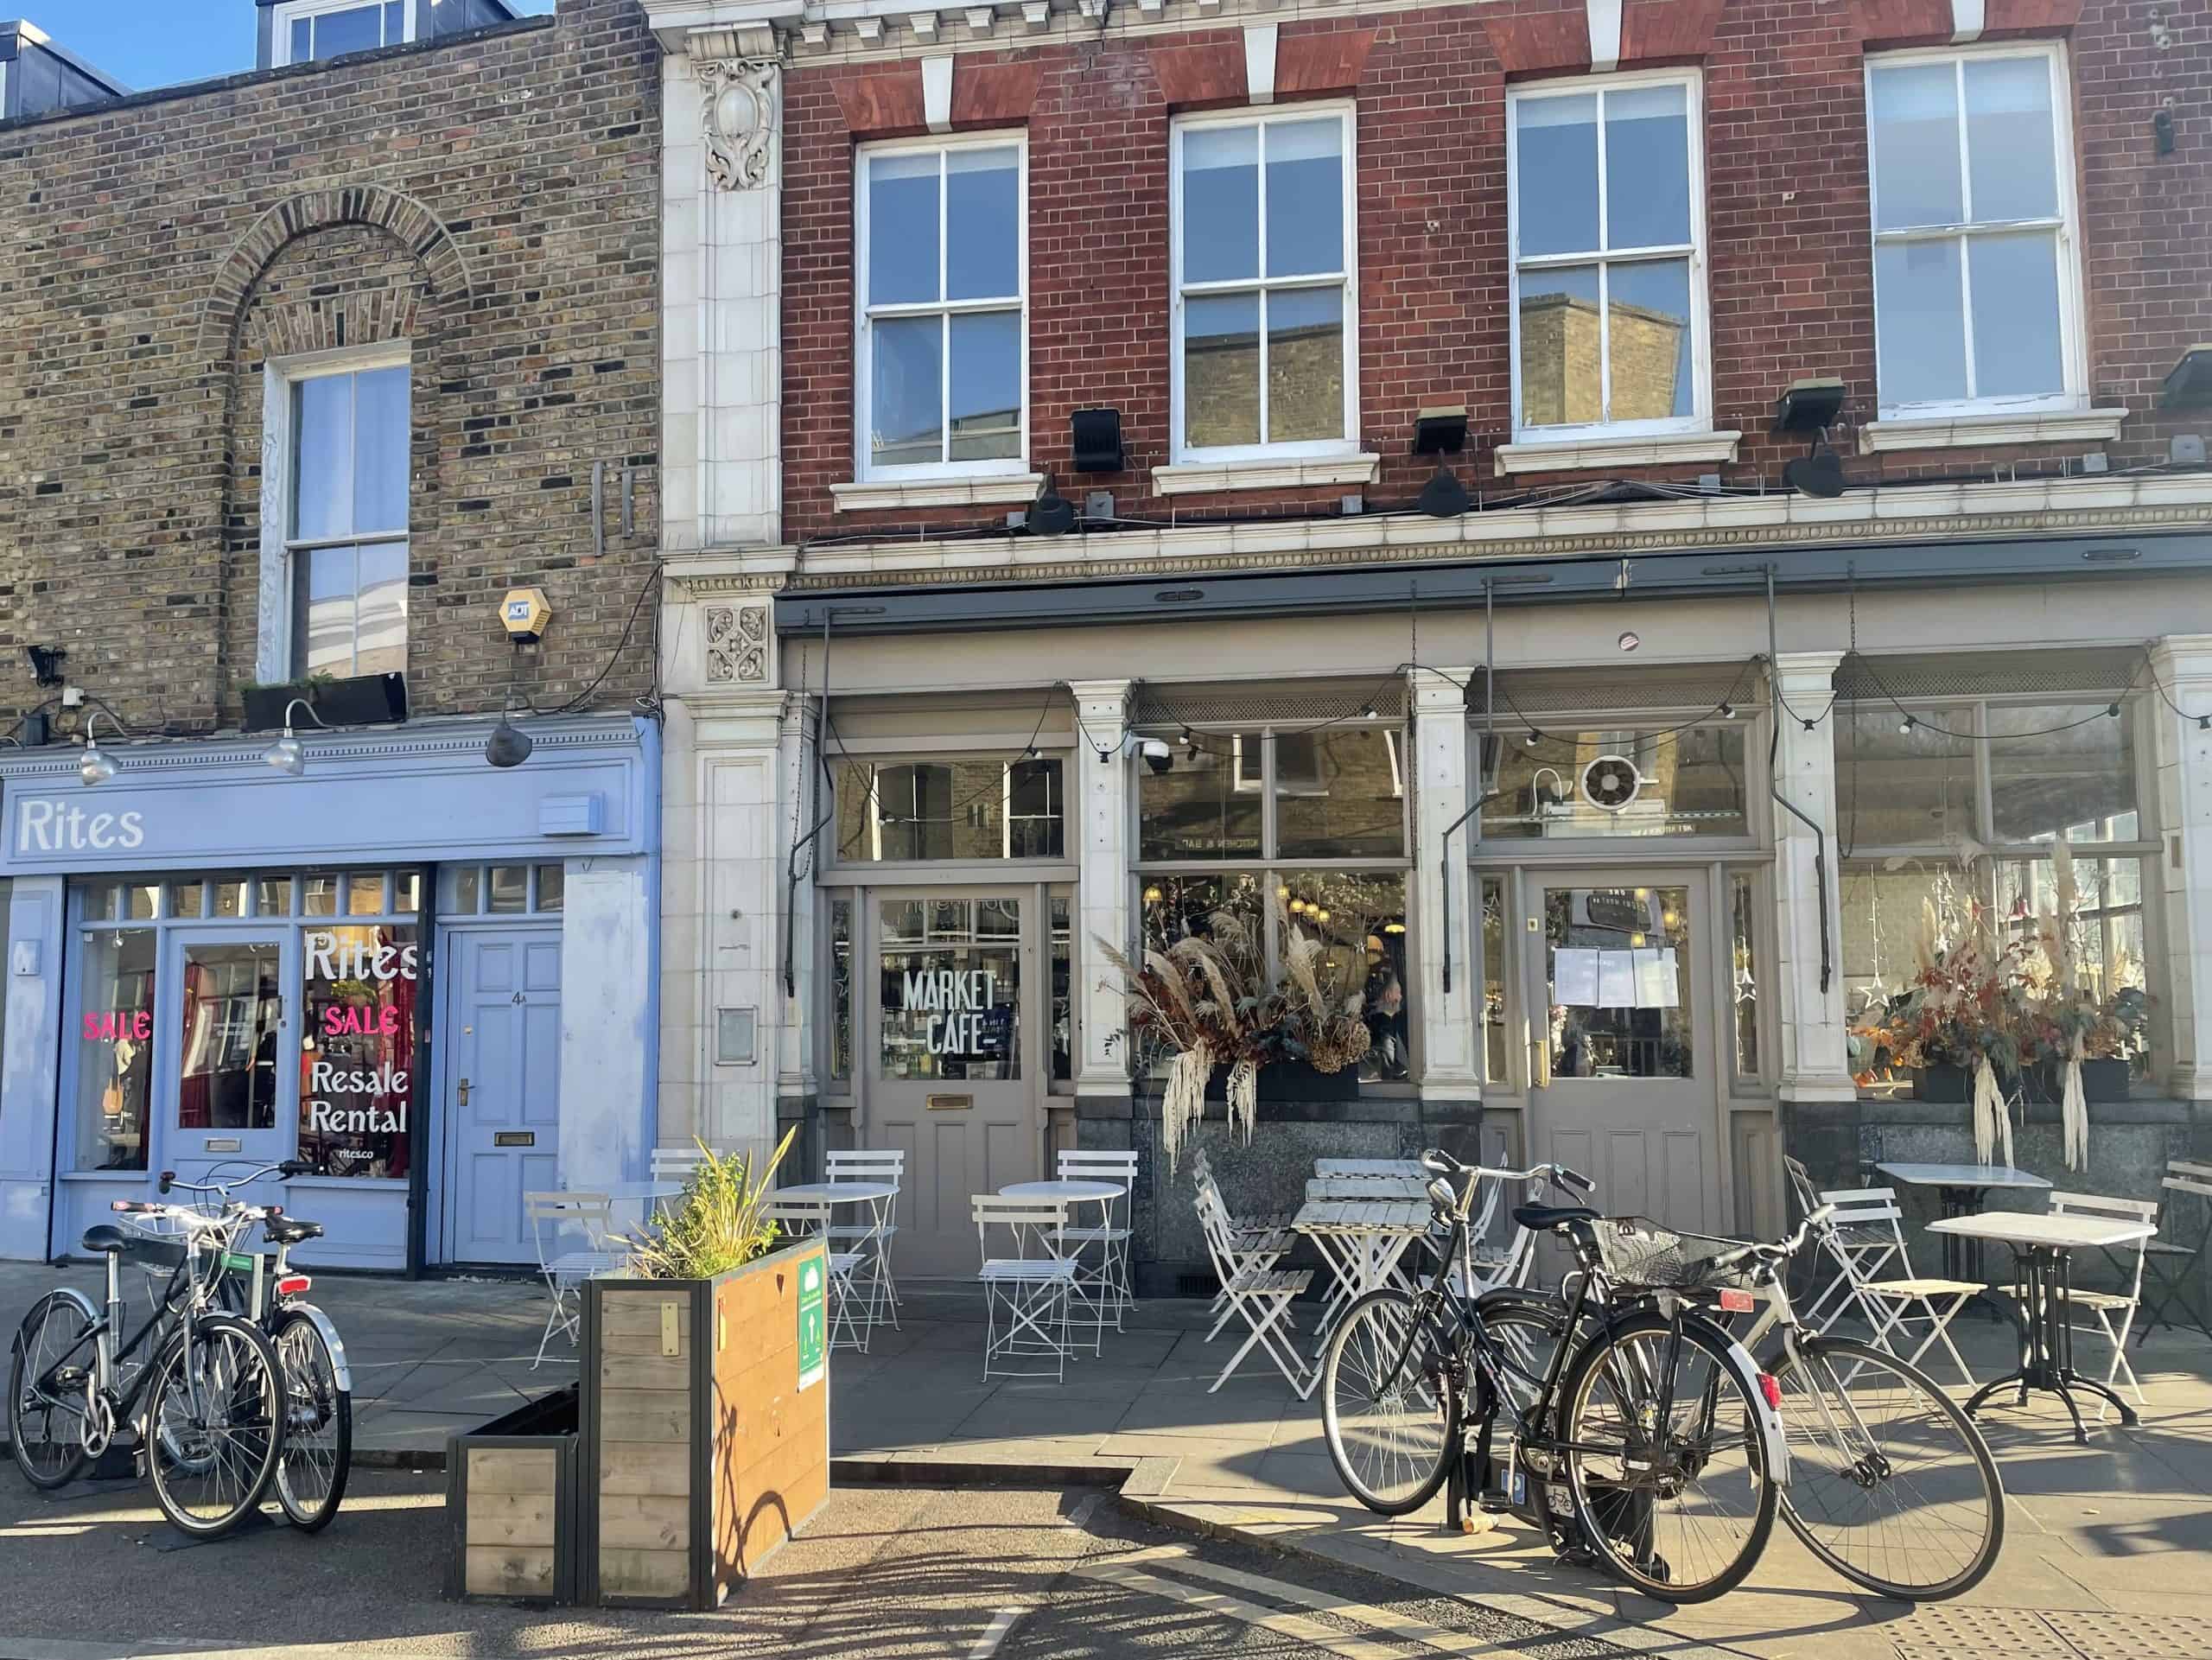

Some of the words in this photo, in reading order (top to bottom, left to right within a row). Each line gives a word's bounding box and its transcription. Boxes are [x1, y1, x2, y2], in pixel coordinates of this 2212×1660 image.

[508, 603, 531, 616] ADT
[20, 800, 144, 851] Rites
[304, 931, 417, 981] Rites
[512, 990, 527, 1006] 4A
[903, 970, 996, 1010] MARKET
[83, 1010, 151, 1040] SALE
[324, 1005, 399, 1035] SALE
[926, 1010, 983, 1054] CAFE
[311, 1061, 409, 1093] Resale
[310, 1100, 408, 1133] Rental
